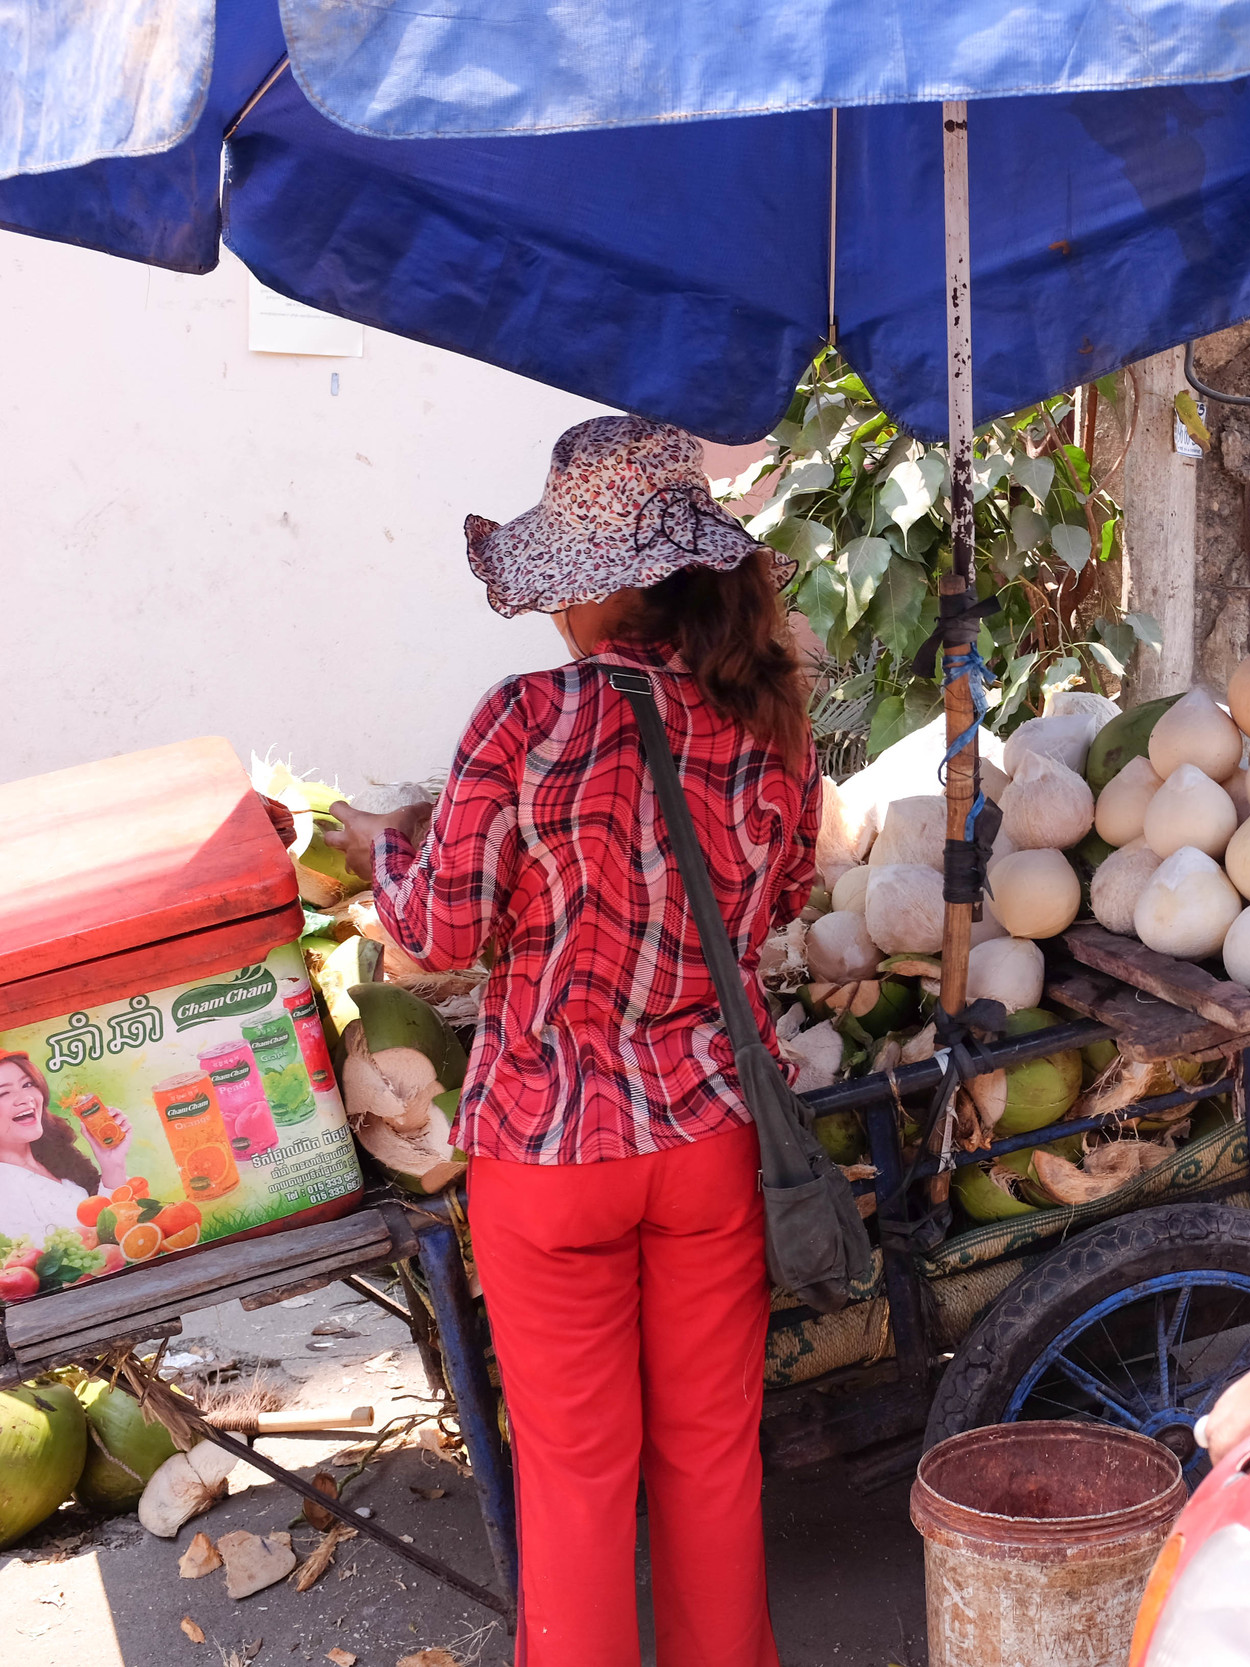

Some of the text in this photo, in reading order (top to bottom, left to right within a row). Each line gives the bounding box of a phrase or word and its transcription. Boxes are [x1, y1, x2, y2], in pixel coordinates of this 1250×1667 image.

[219, 1079, 251, 1095] Peach
[285, 1190, 298, 1202] Tel
[307, 1182, 324, 1195] 015
[326, 1176, 343, 1189] 333
[310, 1191, 327, 1204] 015
[329, 1184, 345, 1197] 333
